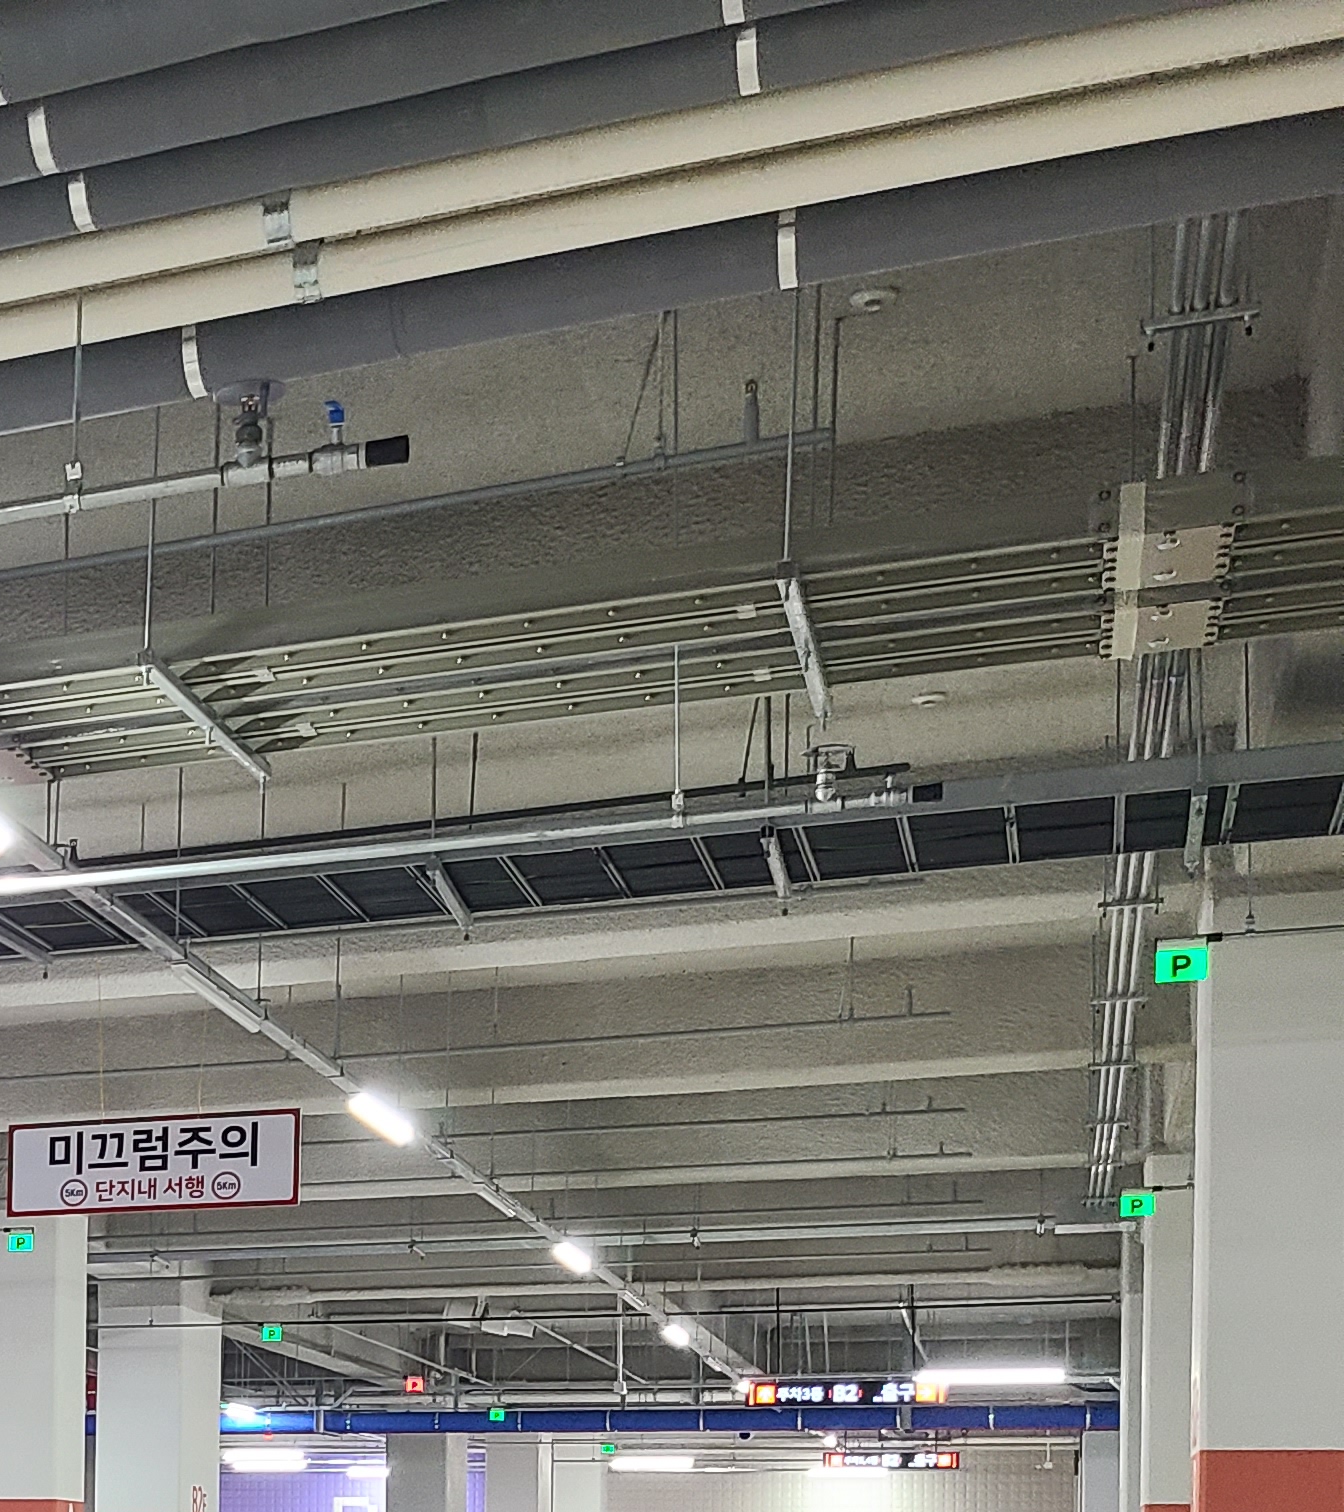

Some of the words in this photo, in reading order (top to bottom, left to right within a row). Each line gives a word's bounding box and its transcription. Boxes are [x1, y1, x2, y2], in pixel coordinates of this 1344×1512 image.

[1172, 954, 1192, 978] P
[48, 1121, 259, 1175] 미끄럼주의
[64, 1188, 84, 1198] 5Km
[95, 1177, 158, 1203] 단지내
[162, 1174, 205, 1200] 서행
[1131, 1199, 1144, 1214] P
[15, 1236, 26, 1249] P
[268, 1329, 276, 1340] P
[833, 1383, 859, 1403] B2
